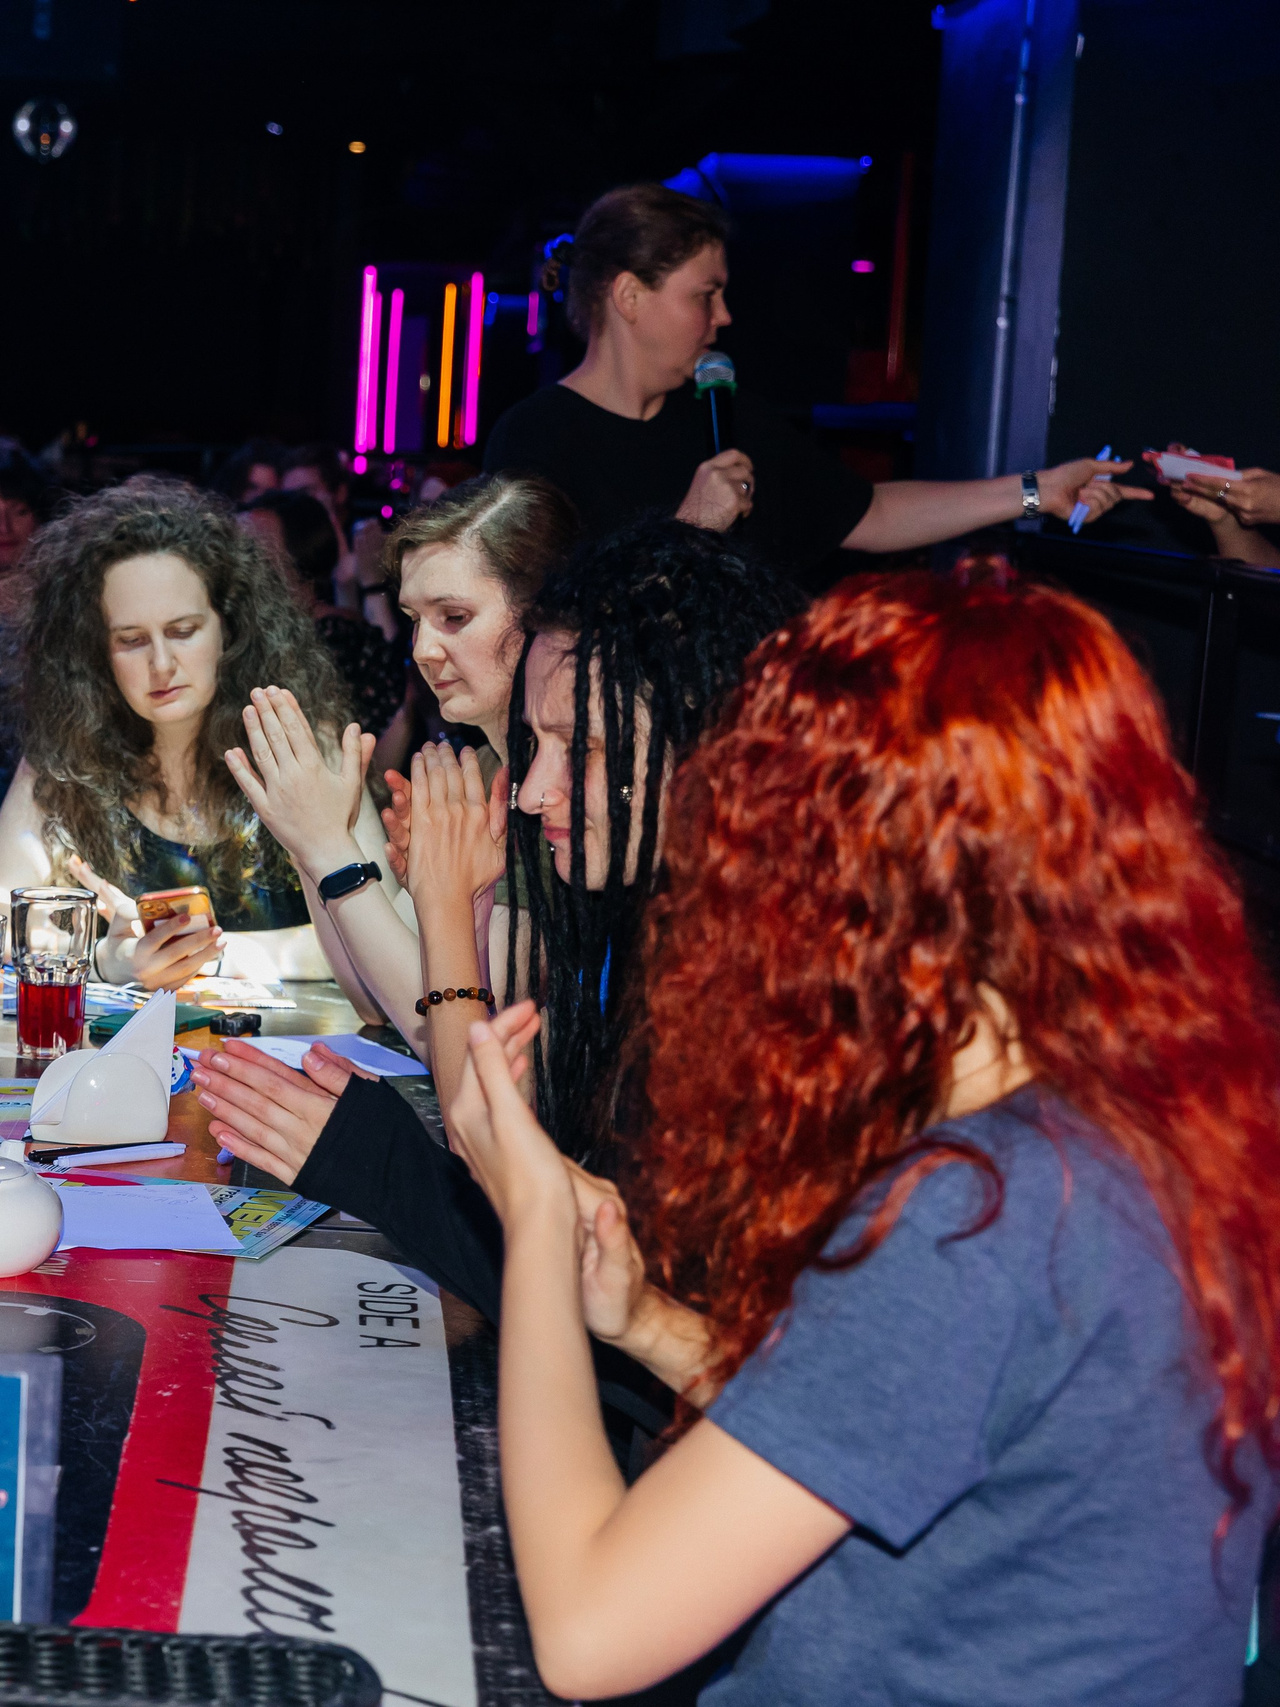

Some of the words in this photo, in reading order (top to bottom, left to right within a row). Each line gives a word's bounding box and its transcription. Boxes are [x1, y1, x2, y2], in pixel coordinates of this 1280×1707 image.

[229, 1190, 299, 1240] МЕН
[356, 1280, 421, 1330] SIDE
[359, 1334, 421, 1349] A
[156, 1432, 336, 1634] погромч
